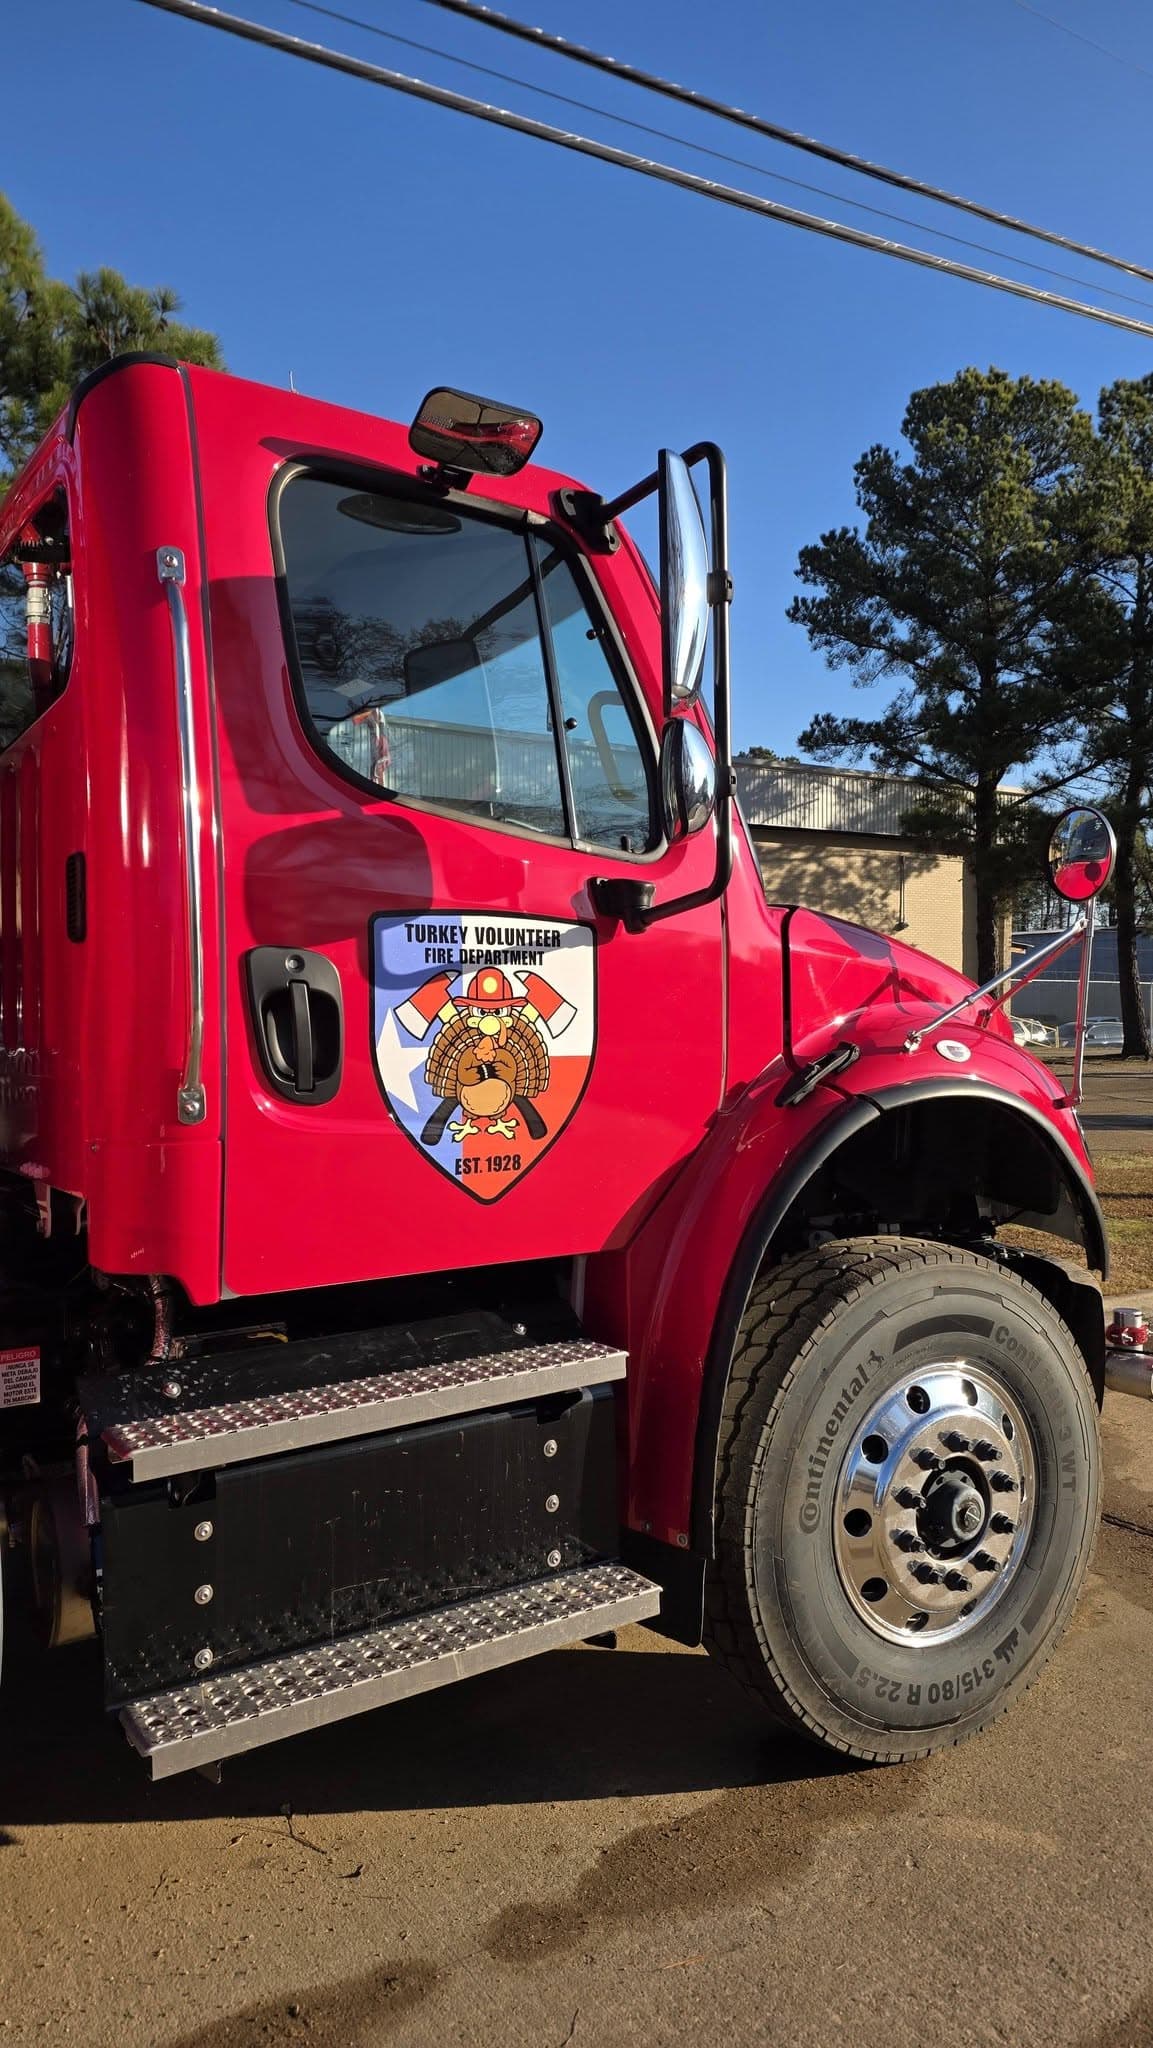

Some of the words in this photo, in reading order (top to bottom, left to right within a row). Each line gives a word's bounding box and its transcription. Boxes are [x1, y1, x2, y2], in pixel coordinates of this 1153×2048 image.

[404, 923, 468, 945] TURKEY
[474, 926, 561, 948] VOLUNTEER
[424, 947, 454, 964] FIRE
[459, 949, 545, 966] DEPARTMENT
[455, 1157, 483, 1175] EST.
[485, 1154, 522, 1173] 1928
[1, 1350, 36, 1361] PELIGRO
[994, 1325, 1042, 1373] Conti
[1062, 1449, 1076, 1492] WT
[799, 1364, 870, 1534] Continental
[856, 1666, 903, 1703] 22.5
[927, 1658, 996, 1705] 315/80
[906, 1683, 922, 1706] R
